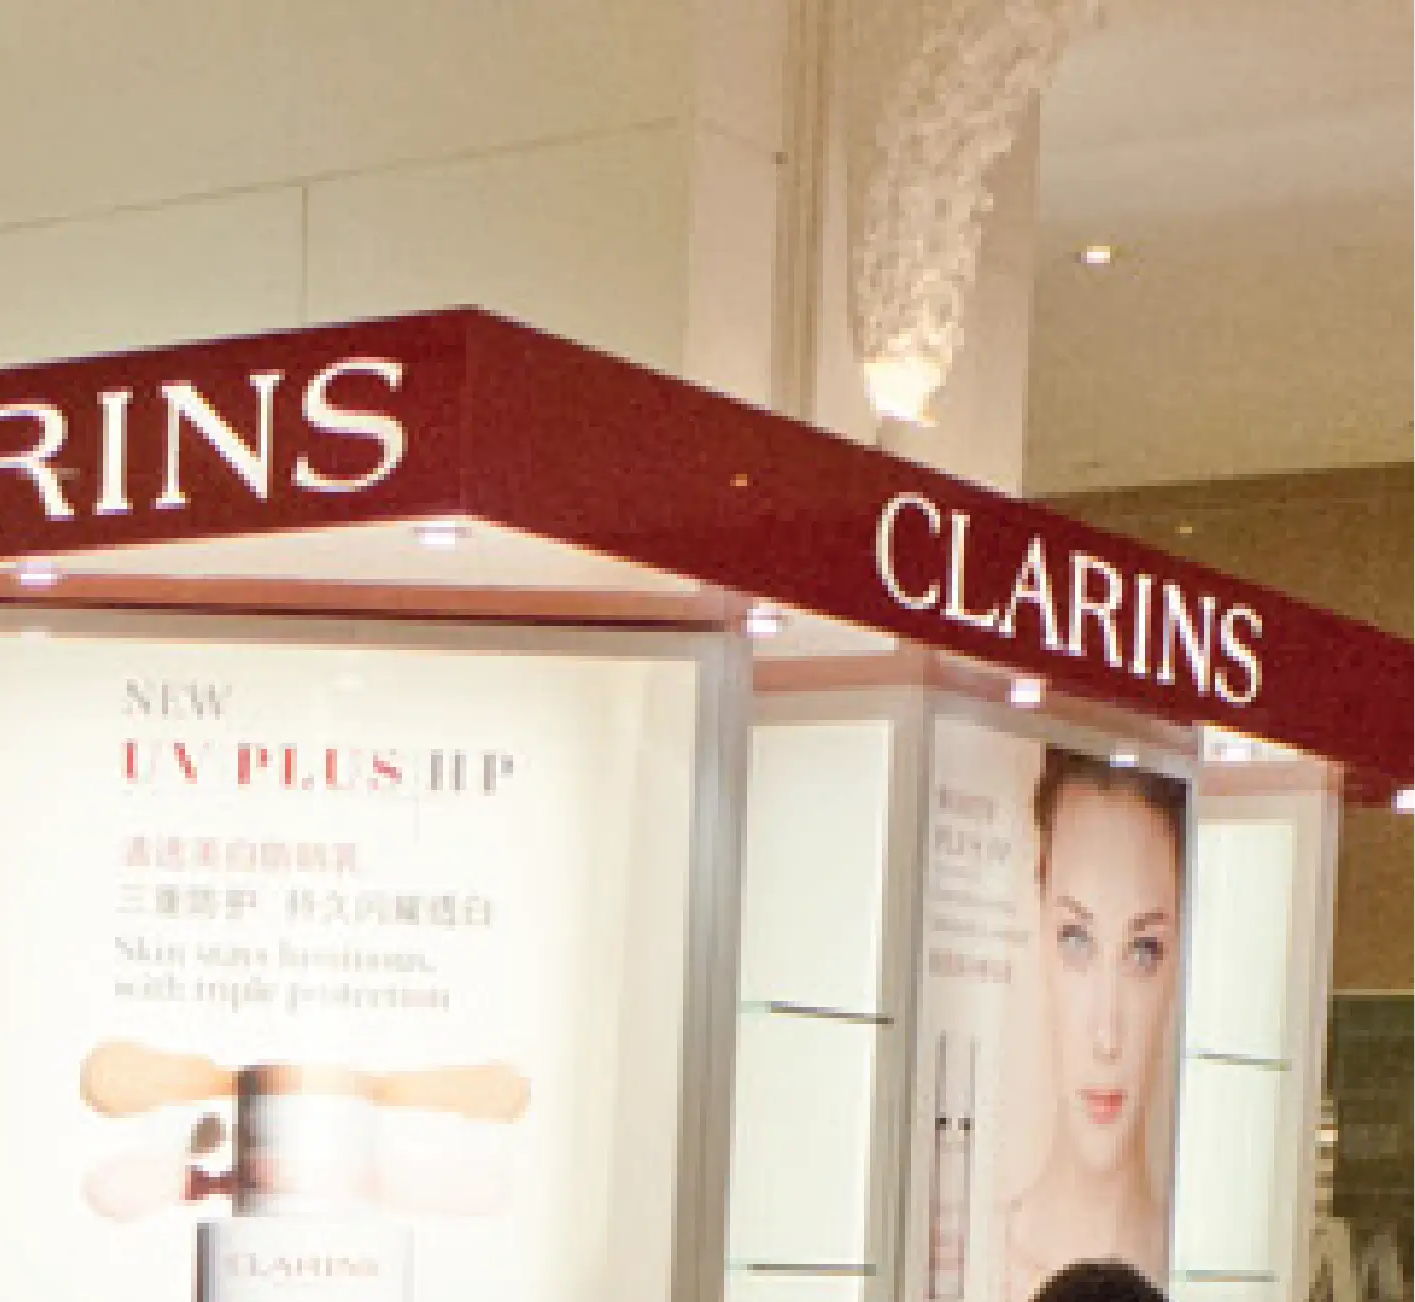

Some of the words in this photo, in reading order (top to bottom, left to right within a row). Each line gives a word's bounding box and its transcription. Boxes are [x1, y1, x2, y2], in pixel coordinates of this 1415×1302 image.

[875, 491, 1265, 709] CLARINS
[124, 678, 232, 720] NEW
[120, 737, 217, 787] UV
[235, 741, 404, 791] PLUS
[427, 748, 516, 797] HP
